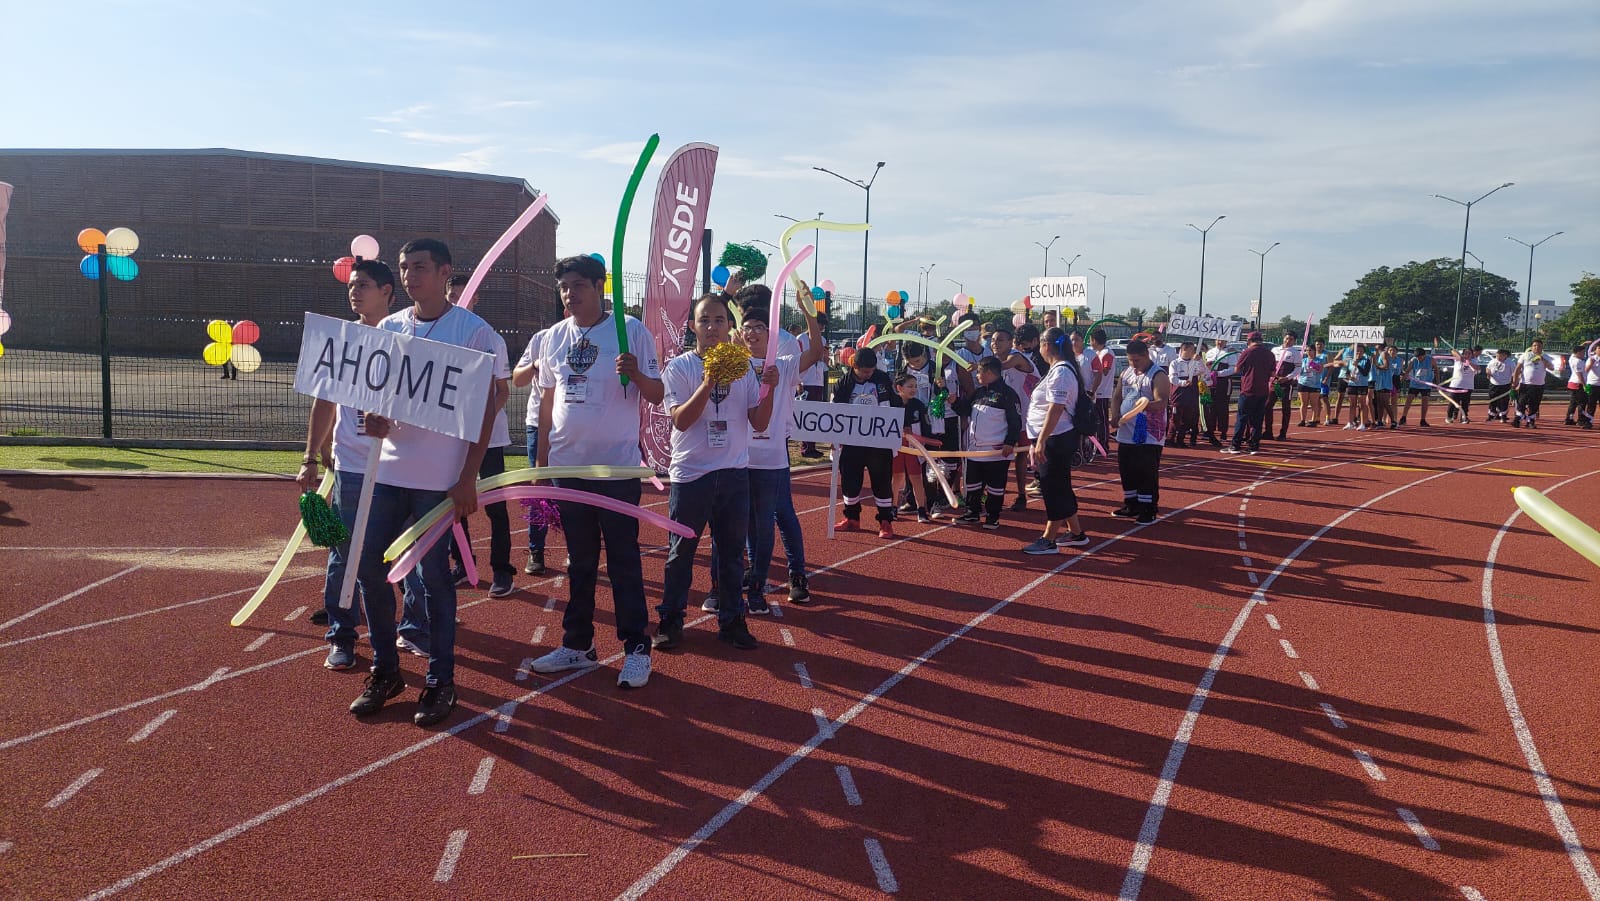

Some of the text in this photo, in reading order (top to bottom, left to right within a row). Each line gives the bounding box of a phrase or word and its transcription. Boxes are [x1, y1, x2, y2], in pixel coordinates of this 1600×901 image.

[663, 181, 699, 263] ISDE
[1030, 282, 1086, 298] ESCUINAPA
[1171, 318, 1238, 337] GUASAVE
[313, 337, 463, 411] AHOME
[793, 410, 901, 438] NGOSTURA
